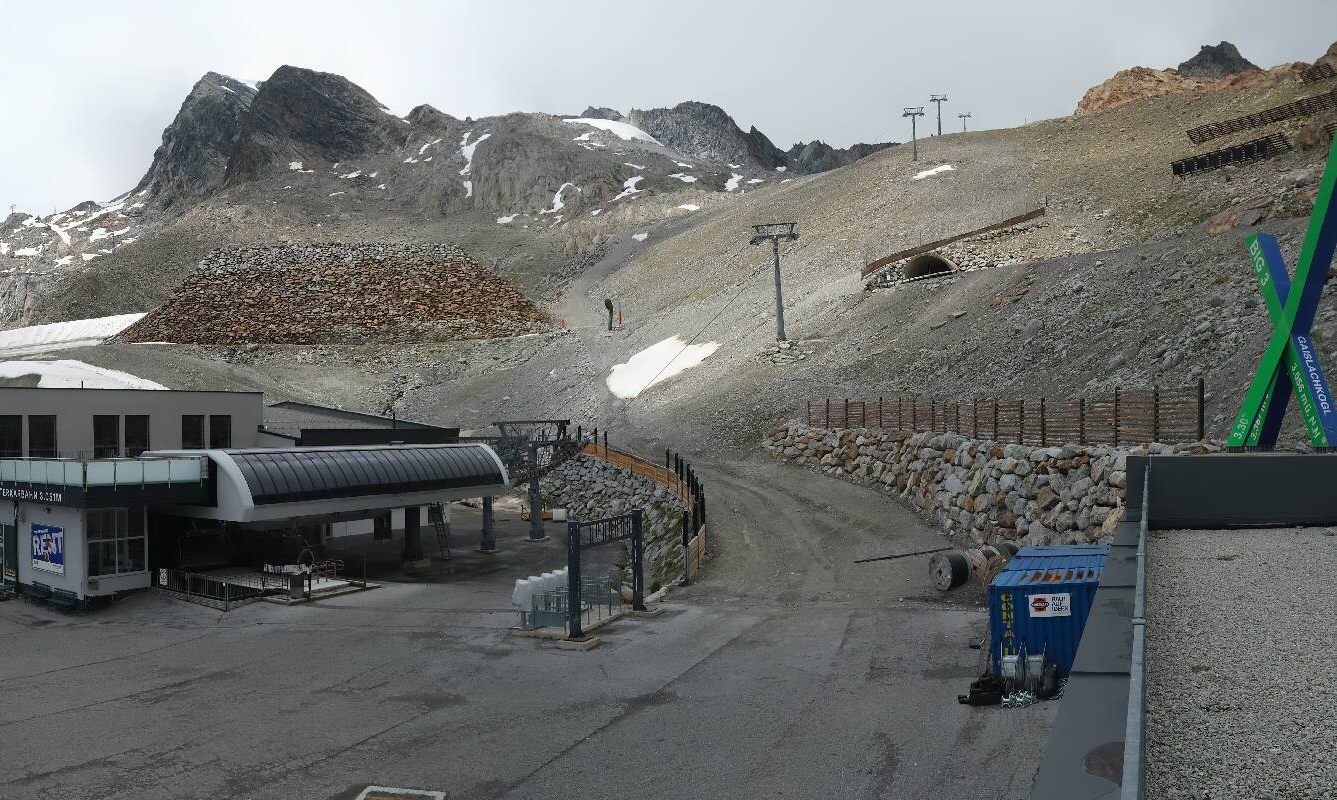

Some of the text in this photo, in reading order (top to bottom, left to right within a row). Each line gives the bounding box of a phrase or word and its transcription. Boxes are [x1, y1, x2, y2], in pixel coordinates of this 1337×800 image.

[1249, 239, 1269, 287] BIG 3
[1297, 335, 1332, 416] GAISLACHKOGL
